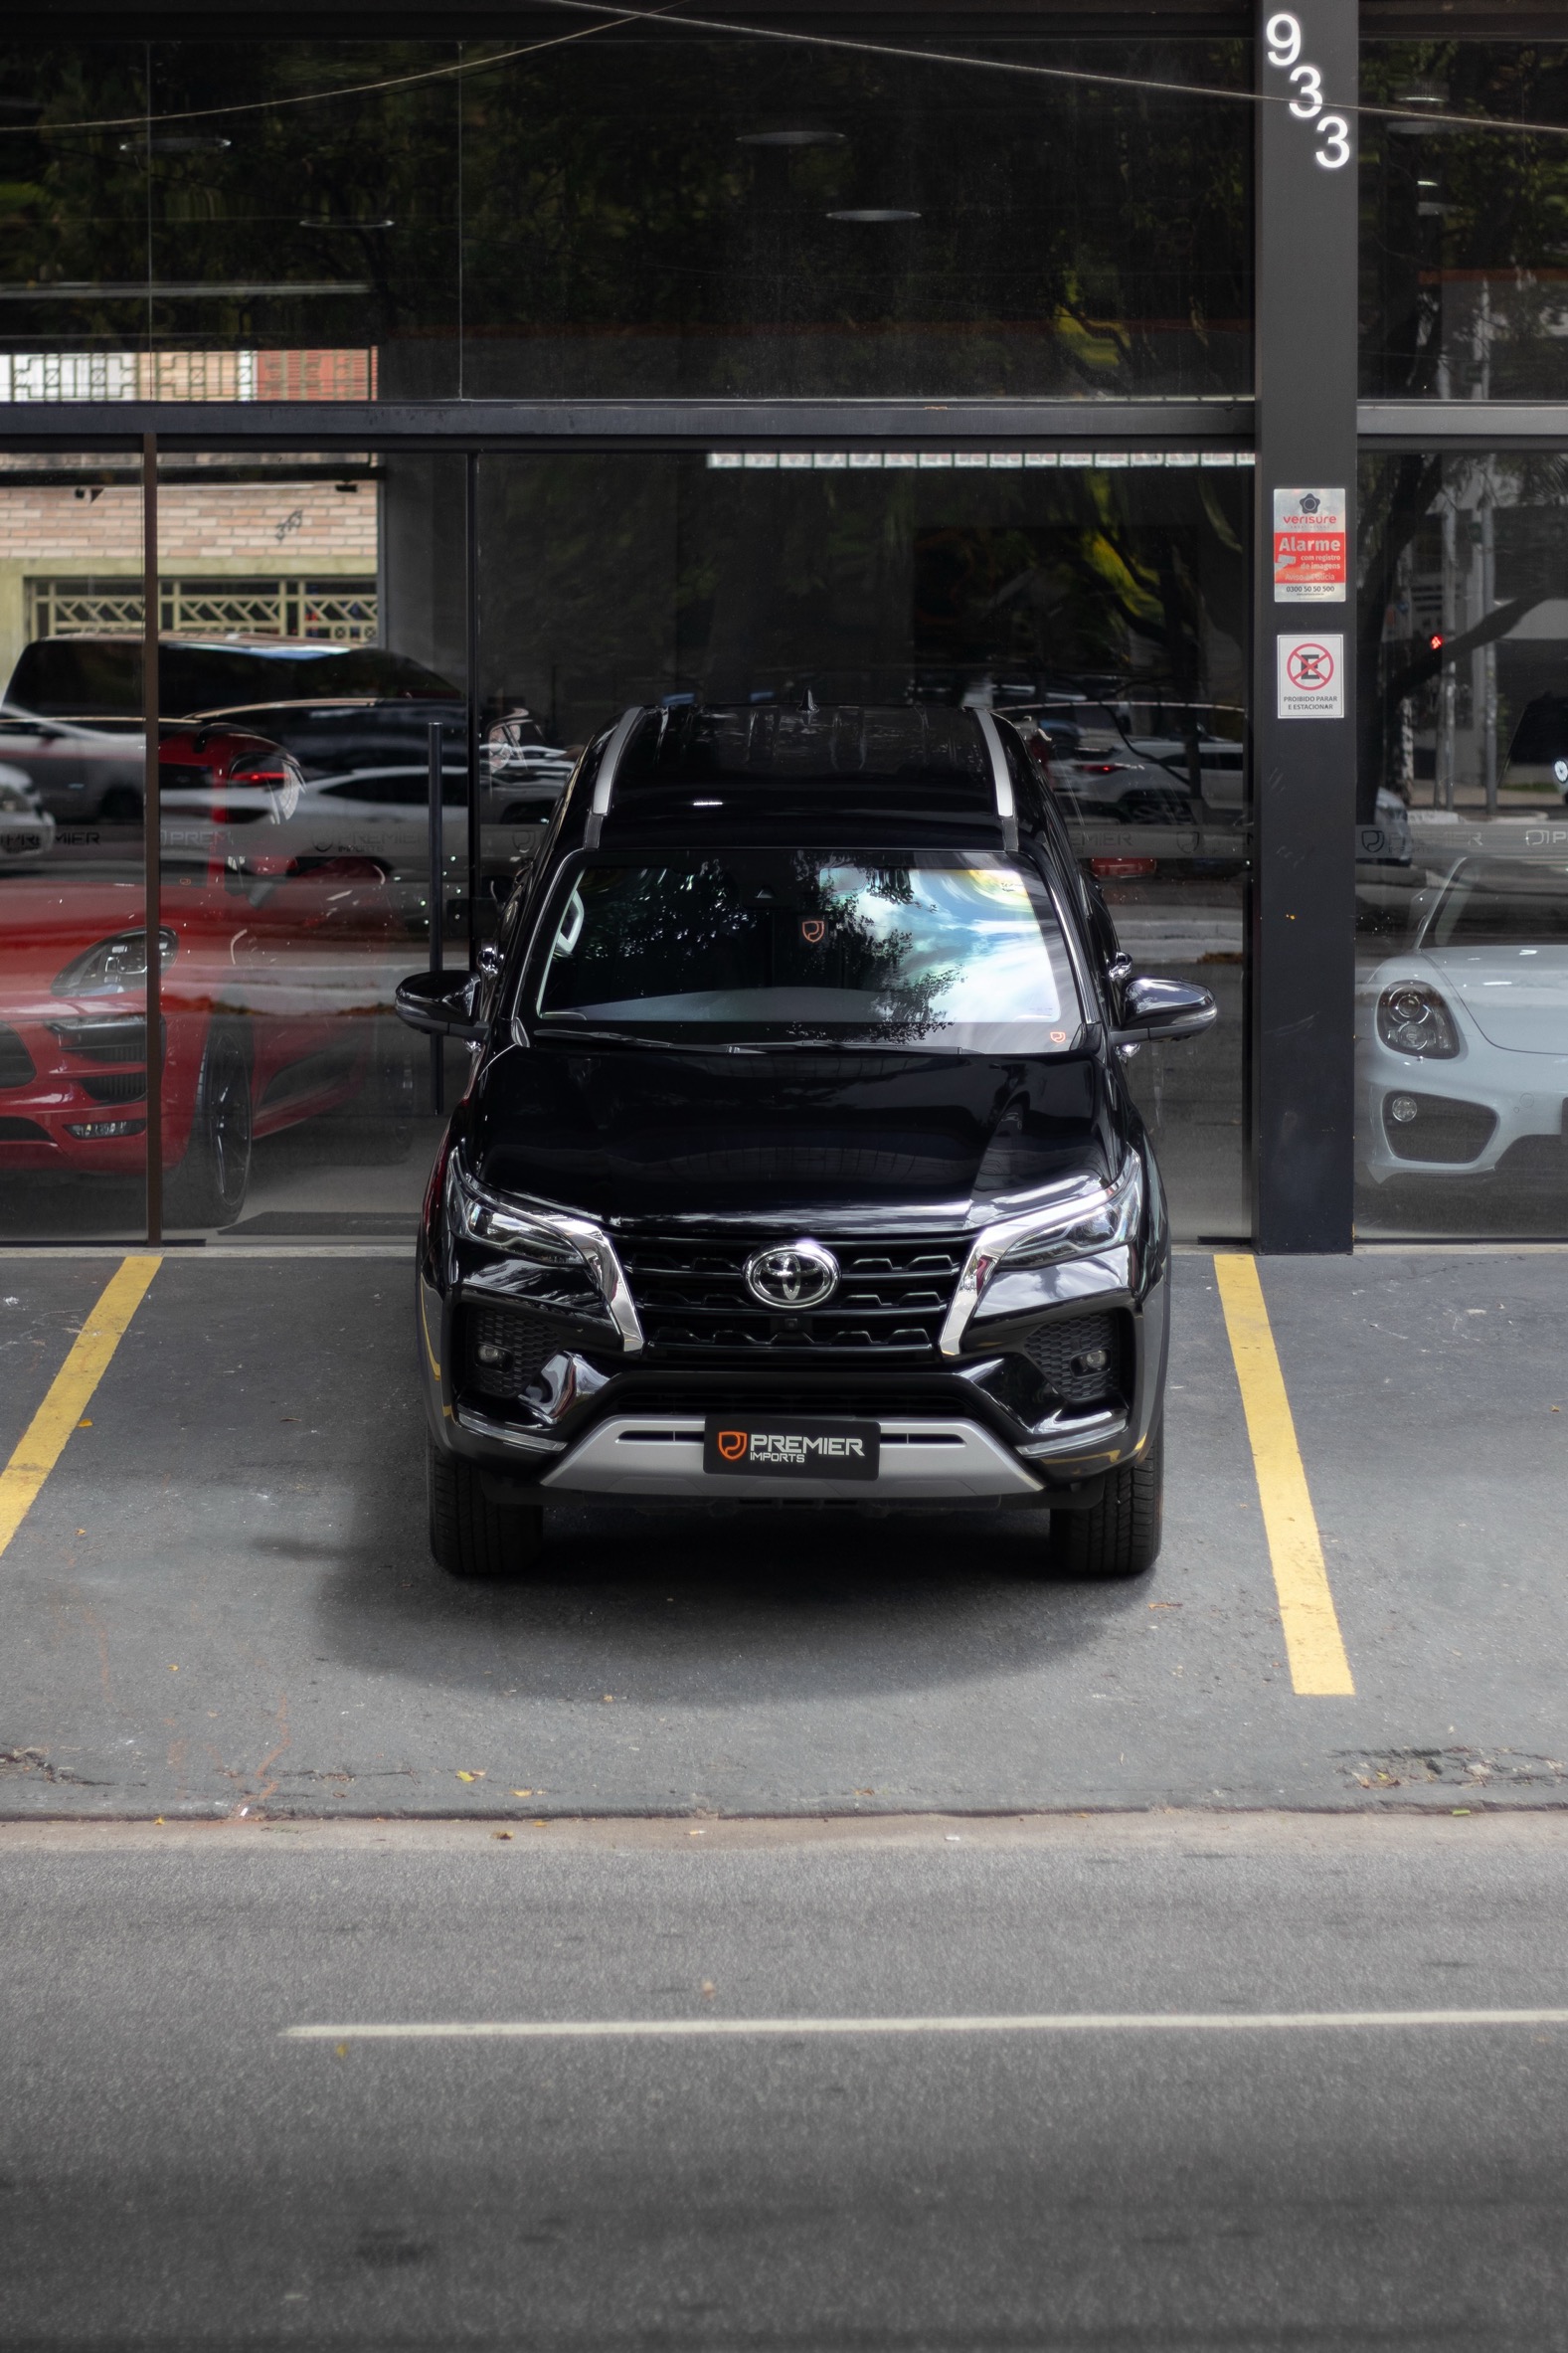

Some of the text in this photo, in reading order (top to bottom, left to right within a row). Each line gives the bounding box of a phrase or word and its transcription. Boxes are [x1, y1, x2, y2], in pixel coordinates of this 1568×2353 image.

[1266, 13, 1350, 169] 933
[1283, 515, 1337, 524] verisure
[1279, 536, 1341, 552] Alarme
[1315, 554, 1341, 564] registro
[1310, 563, 1341, 572] imagens
[750, 1433, 866, 1457] PREMIER
[750, 1451, 806, 1464] IMPORTS
